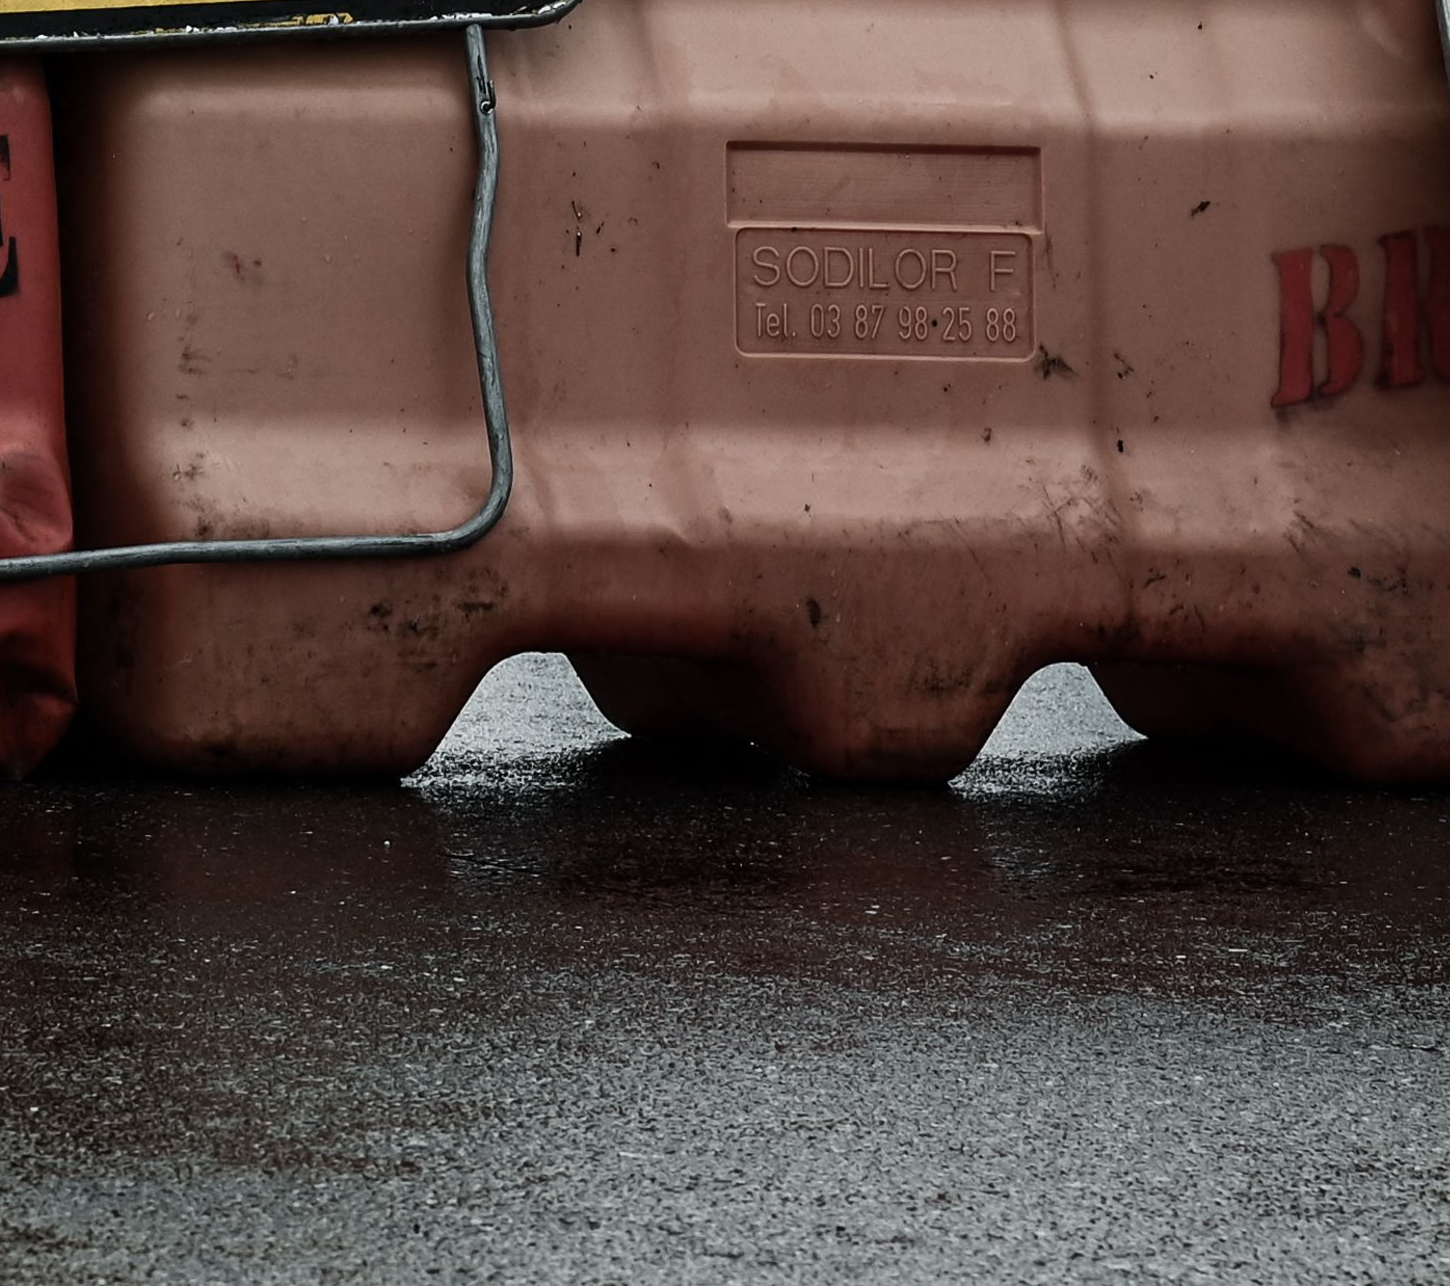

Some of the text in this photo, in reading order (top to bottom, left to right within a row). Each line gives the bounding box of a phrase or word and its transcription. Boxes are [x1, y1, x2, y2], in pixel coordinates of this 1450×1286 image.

[751, 245, 1017, 292] SODILOR F
[754, 303, 1017, 343] Tel. 03 87 98 25 88
